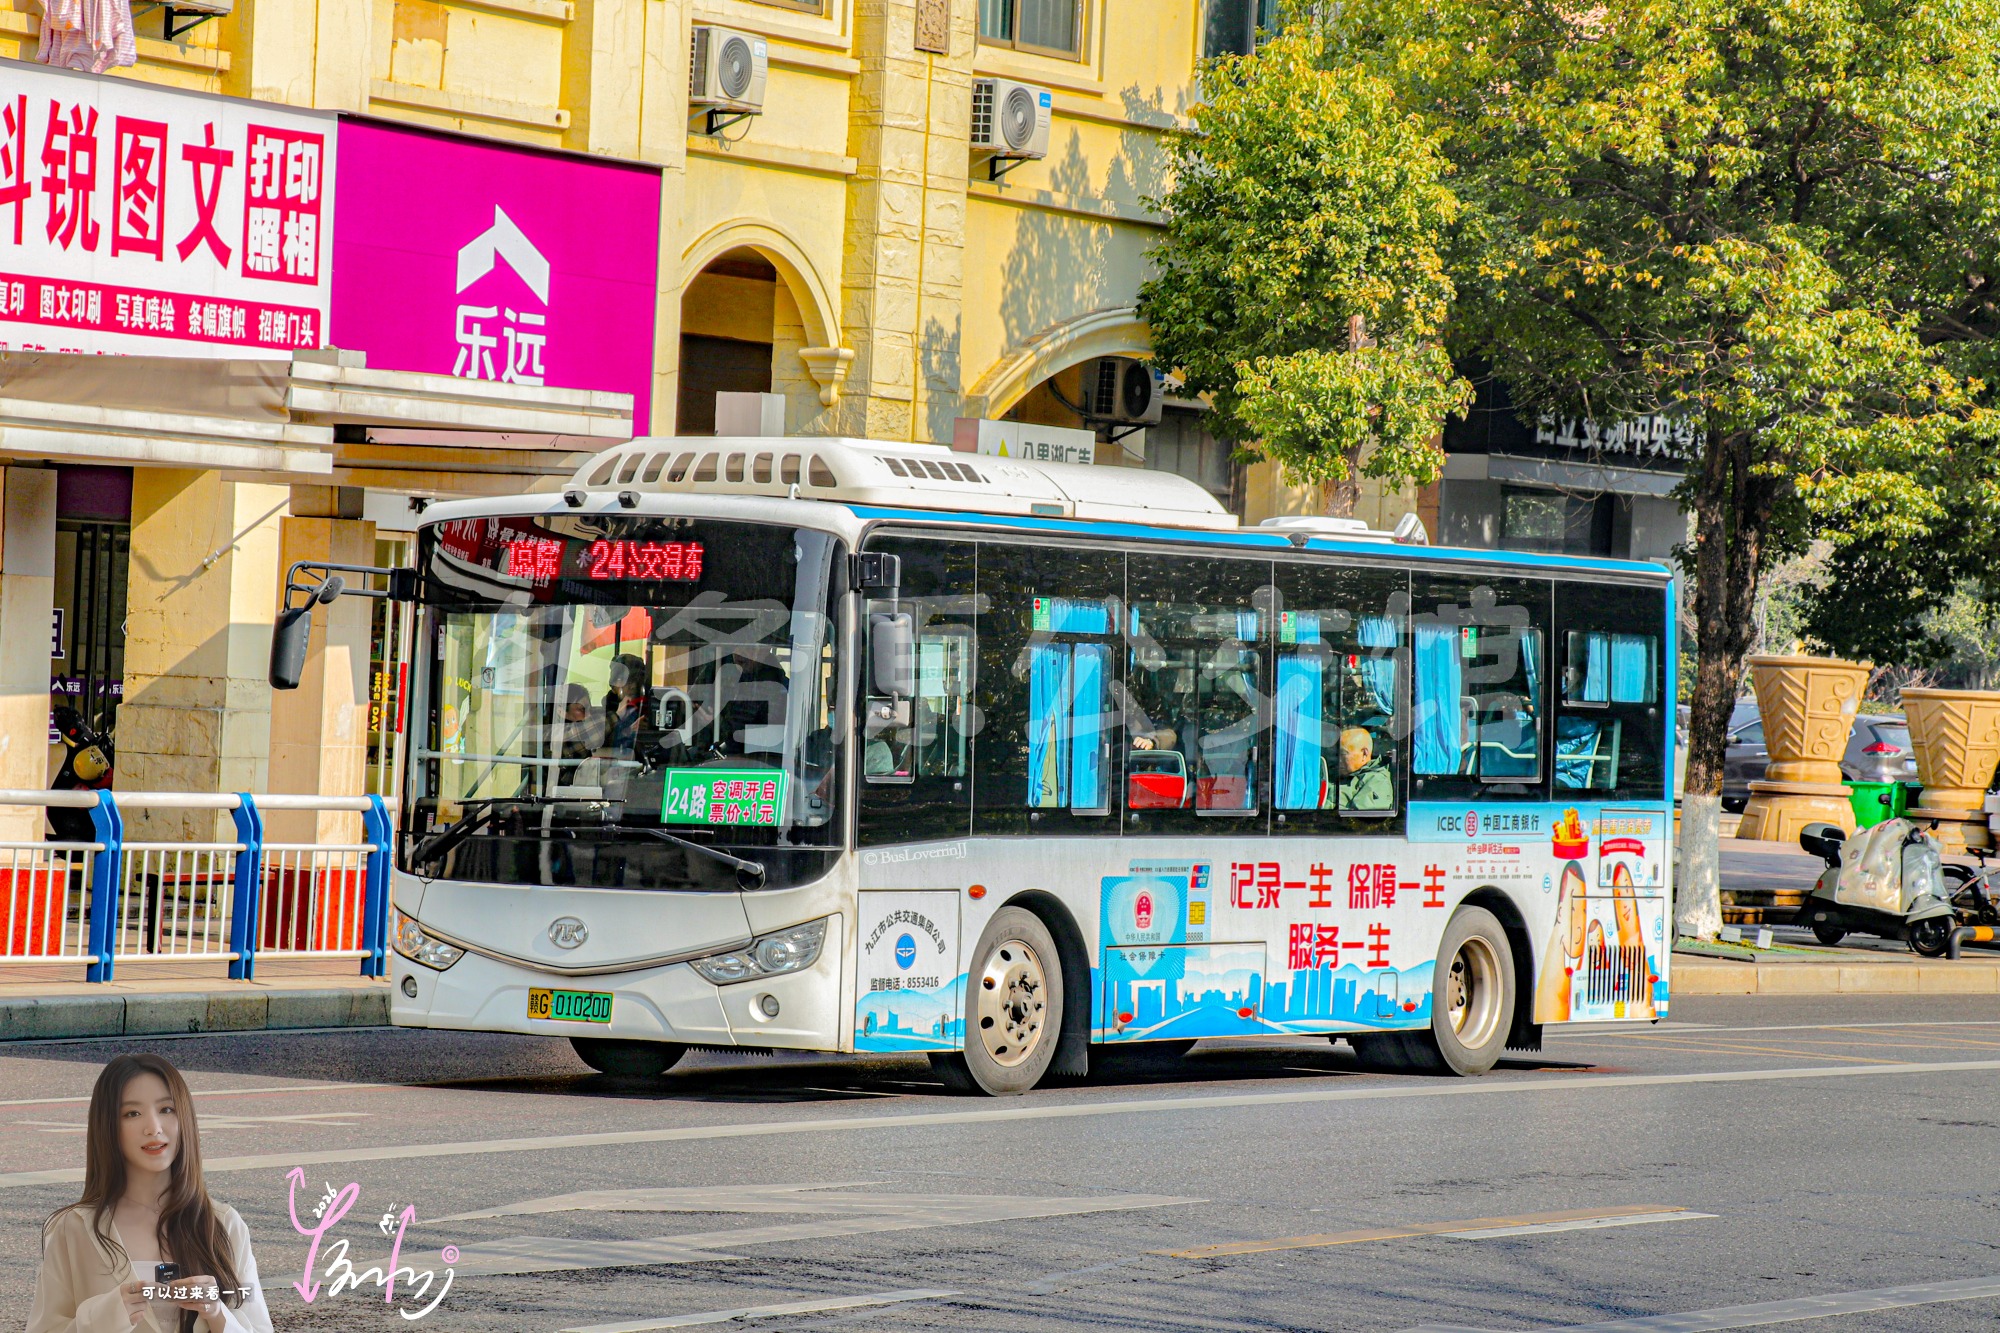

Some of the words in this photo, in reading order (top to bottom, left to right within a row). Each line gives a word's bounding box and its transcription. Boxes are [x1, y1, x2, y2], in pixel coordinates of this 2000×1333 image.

[249, 134, 320, 205] 打印
[246, 206, 317, 278] 照相
[39, 284, 102, 325] 图文印刷
[115, 293, 175, 333] 写真喷绘
[188, 301, 247, 339] 条幅旗帜
[258, 309, 315, 347] 招牌门头
[452, 304, 547, 387] 乐远
[1023, 441, 1091, 464] 八里湖广告
[66, 681, 81, 693] 乐远
[373, 671, 382, 701] NICE
[371, 706, 380, 732] DAY
[668, 784, 707, 819] 24路
[712, 780, 776, 801] 空调开启
[708, 801, 774, 824] 票价+1元
[1437, 816, 1462, 831] ICBC
[1483, 814, 1540, 831] 中国工商银行
[1230, 862, 1334, 909] 记录一生
[1347, 863, 1446, 909] 保障一生
[864, 909, 946, 955] 九江市公共交通集团公司
[1125, 932, 1161, 942] 中华人民共和国
[1287, 922, 1391, 970] 服务一生
[1119, 950, 1166, 961] 社会保障卡
